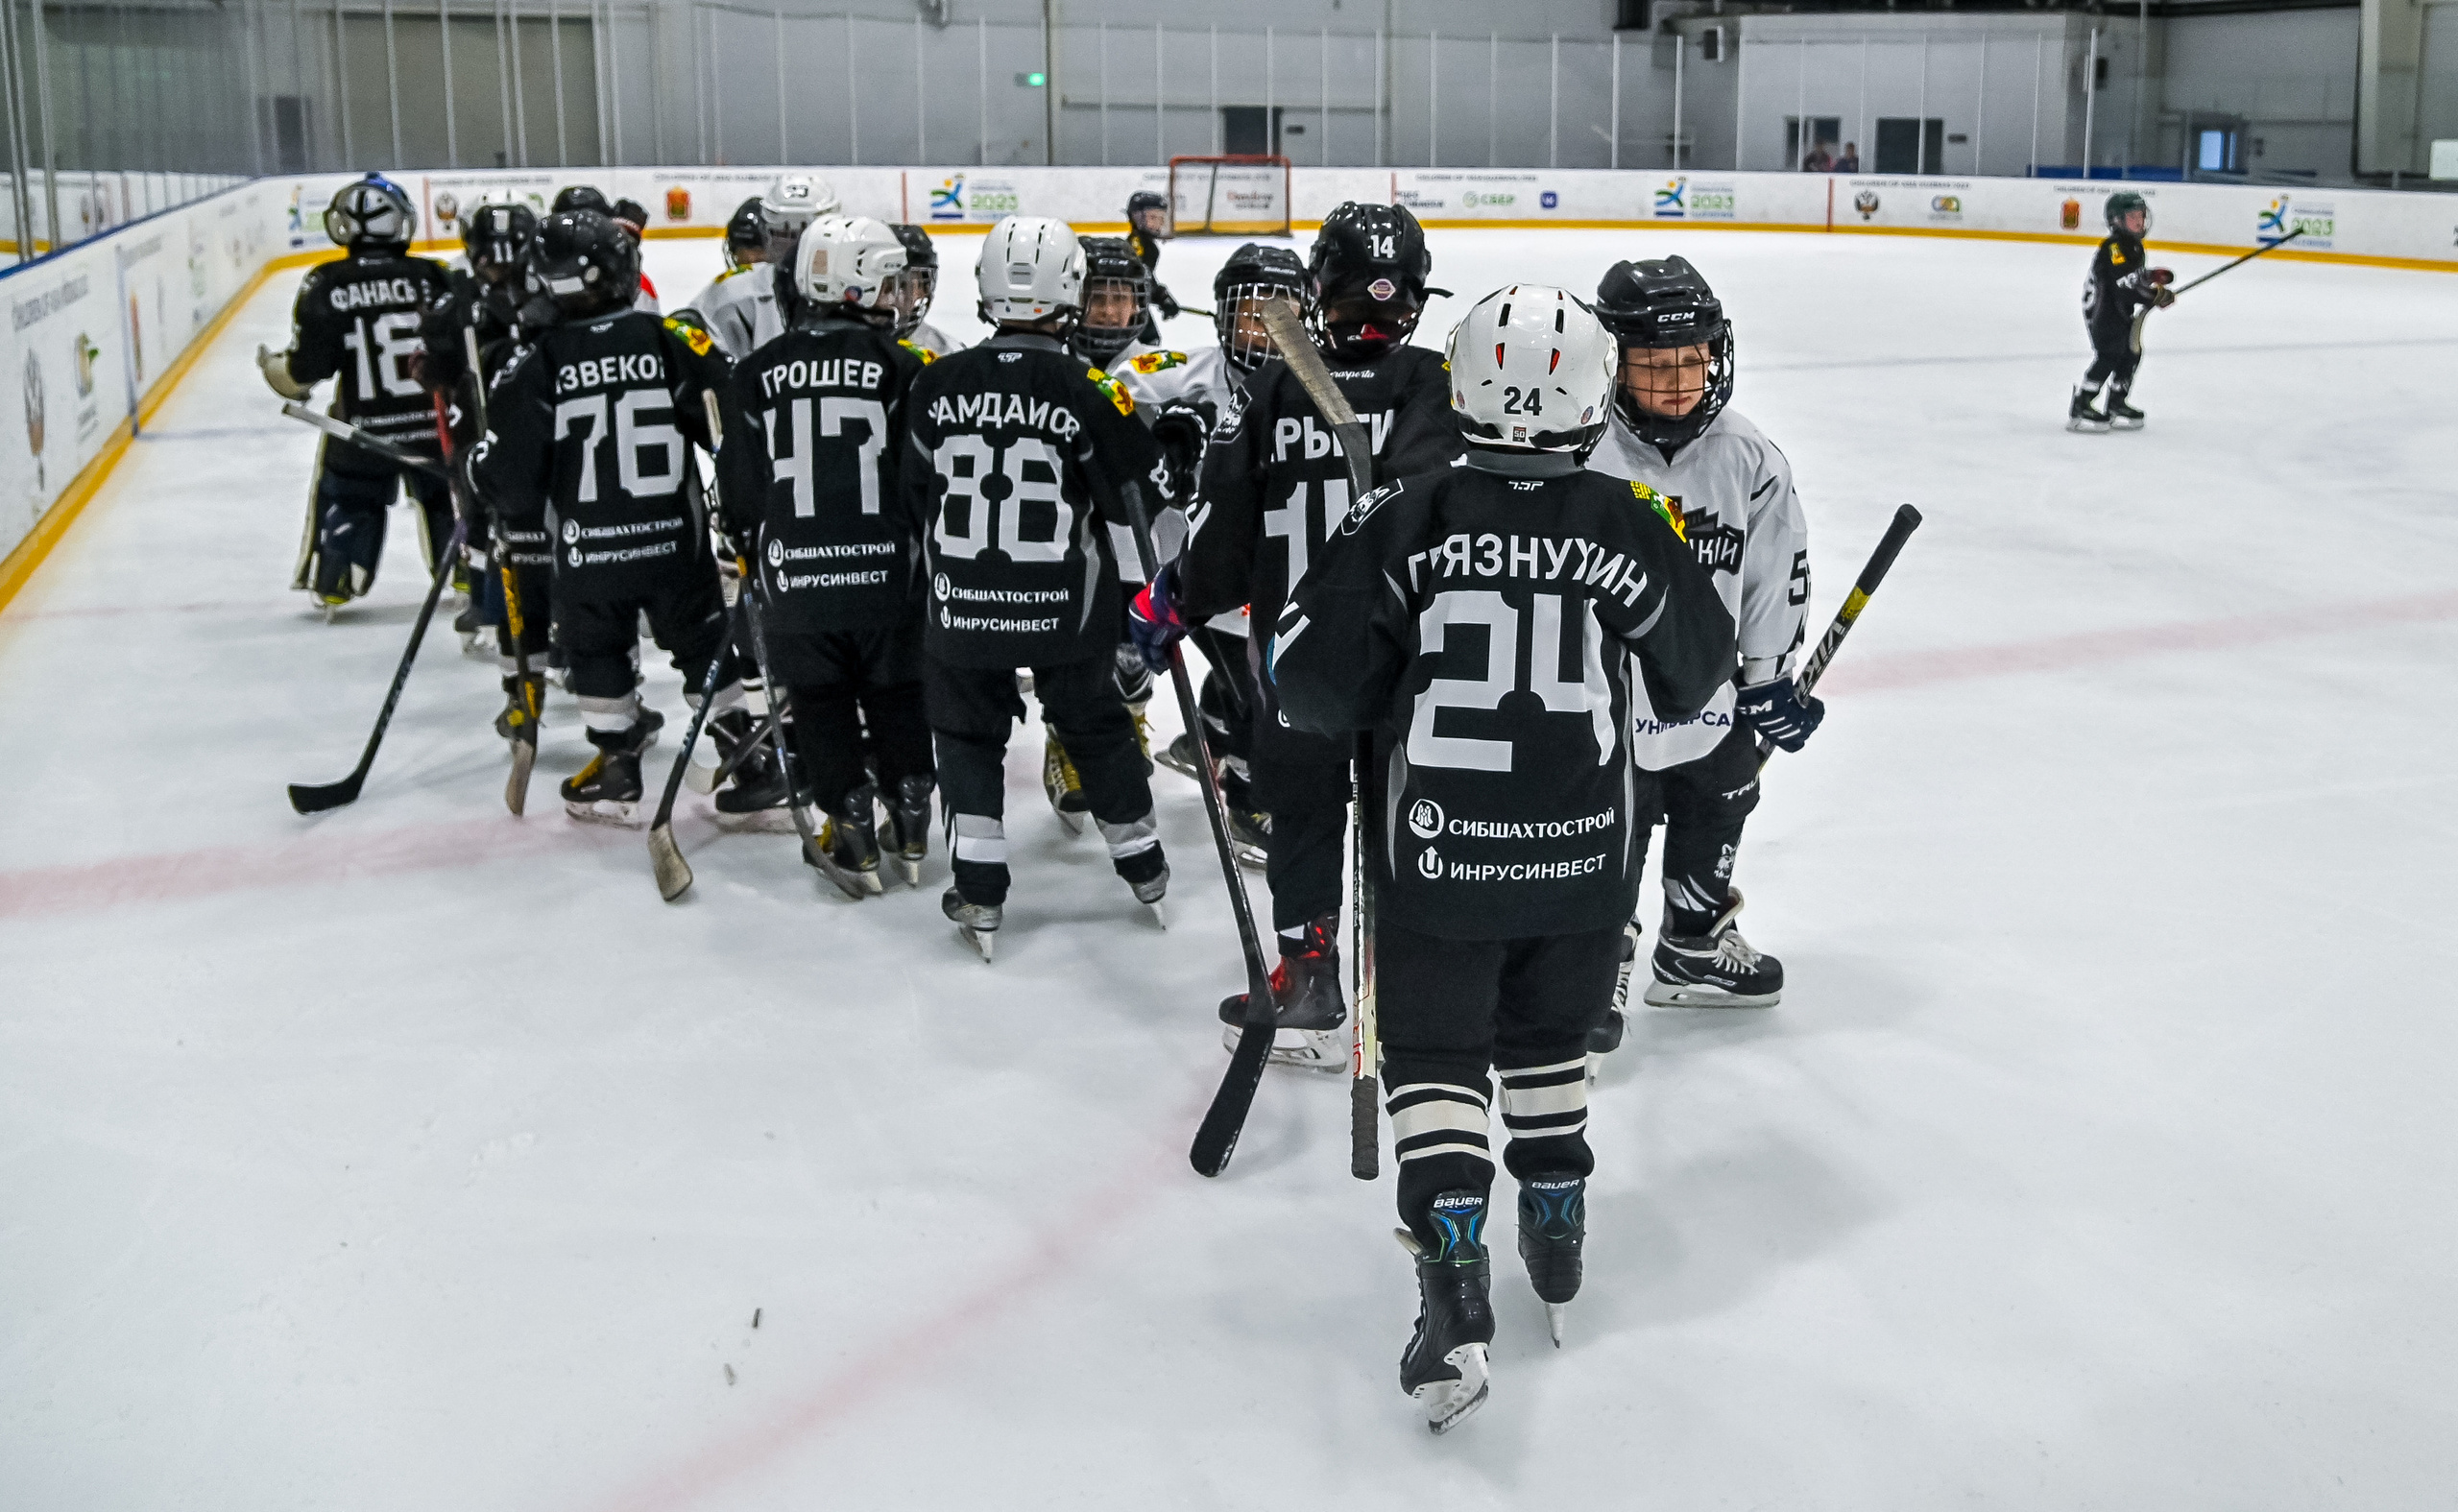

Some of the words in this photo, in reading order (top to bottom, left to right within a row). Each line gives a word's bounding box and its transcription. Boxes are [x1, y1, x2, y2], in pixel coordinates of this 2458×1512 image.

[1691, 195, 1734, 210] 2023
[1370, 234, 1396, 258] 14
[1657, 310, 1696, 324] CCM
[761, 358, 883, 398] ГРОШЕВ
[1504, 386, 1543, 416] 24
[554, 388, 686, 502] 76
[762, 397, 888, 517] 47
[952, 587, 1070, 604] СИБШАХТОСТРОЙ
[952, 615, 1059, 632] ИНРУСИНВЕСТ
[1407, 590, 1616, 772] 24
[1448, 806, 1615, 839] СИБШАХТОСТРОЙ
[1450, 853, 1606, 881] ИНРУСИНВЕСТ
